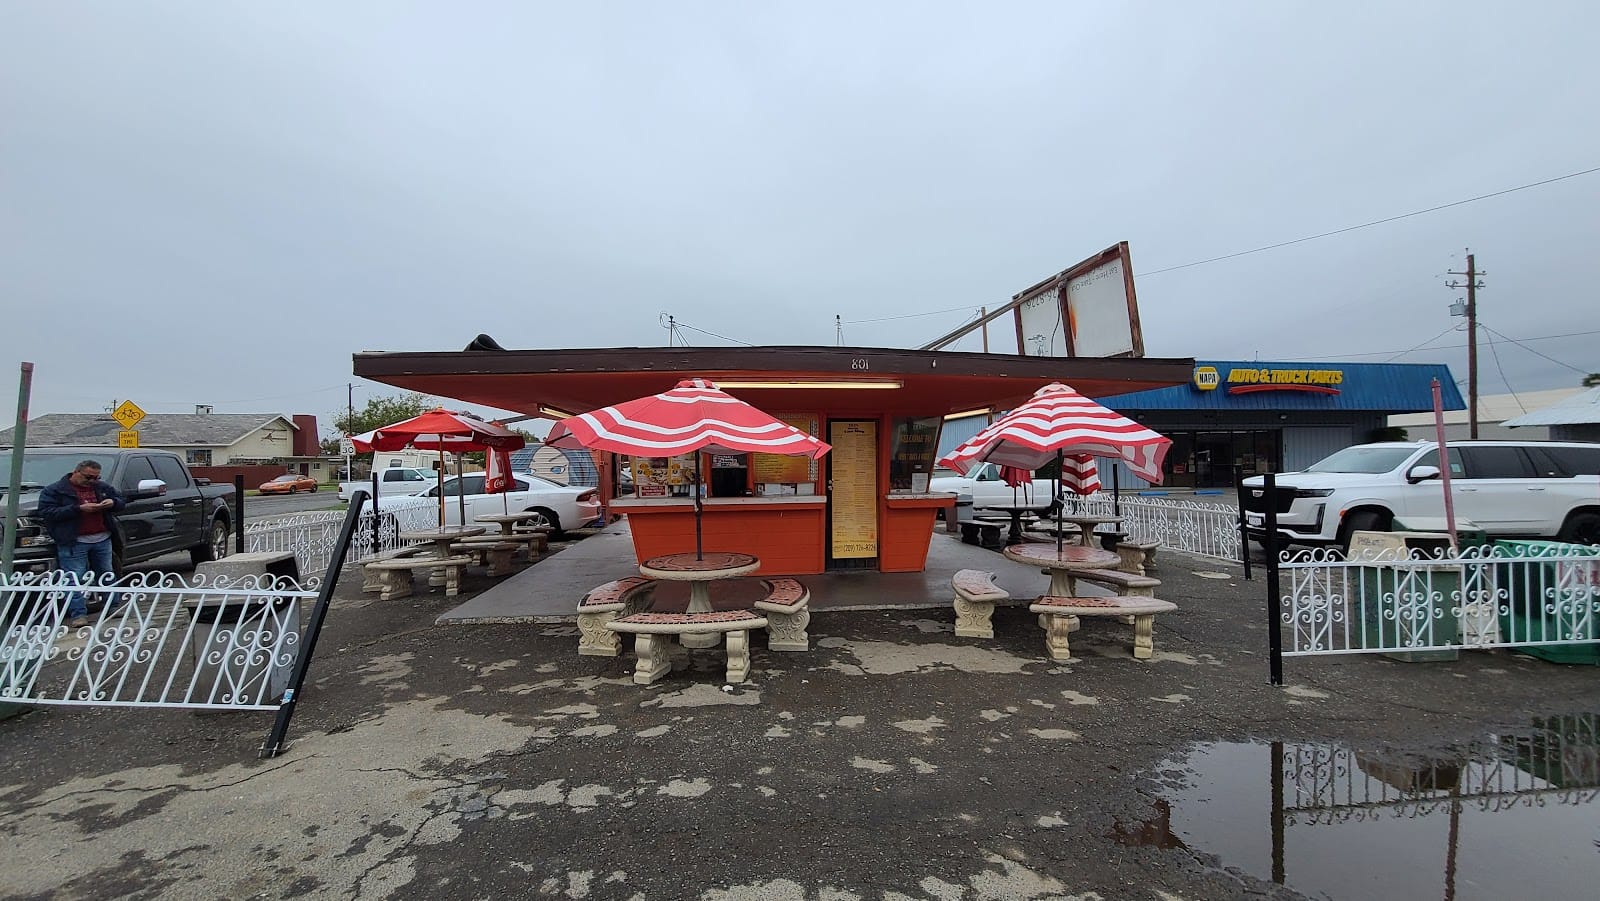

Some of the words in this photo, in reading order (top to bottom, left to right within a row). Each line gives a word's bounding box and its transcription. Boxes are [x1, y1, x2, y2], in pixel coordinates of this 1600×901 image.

[851, 358, 869, 370] 801
[1199, 372, 1217, 384] NAPA
[1227, 369, 1260, 383] AUTO
[1260, 370, 1271, 383] &
[1271, 370, 1308, 384] TRUCK
[1308, 370, 1344, 384] PARTS
[342, 446, 354, 454] 30
